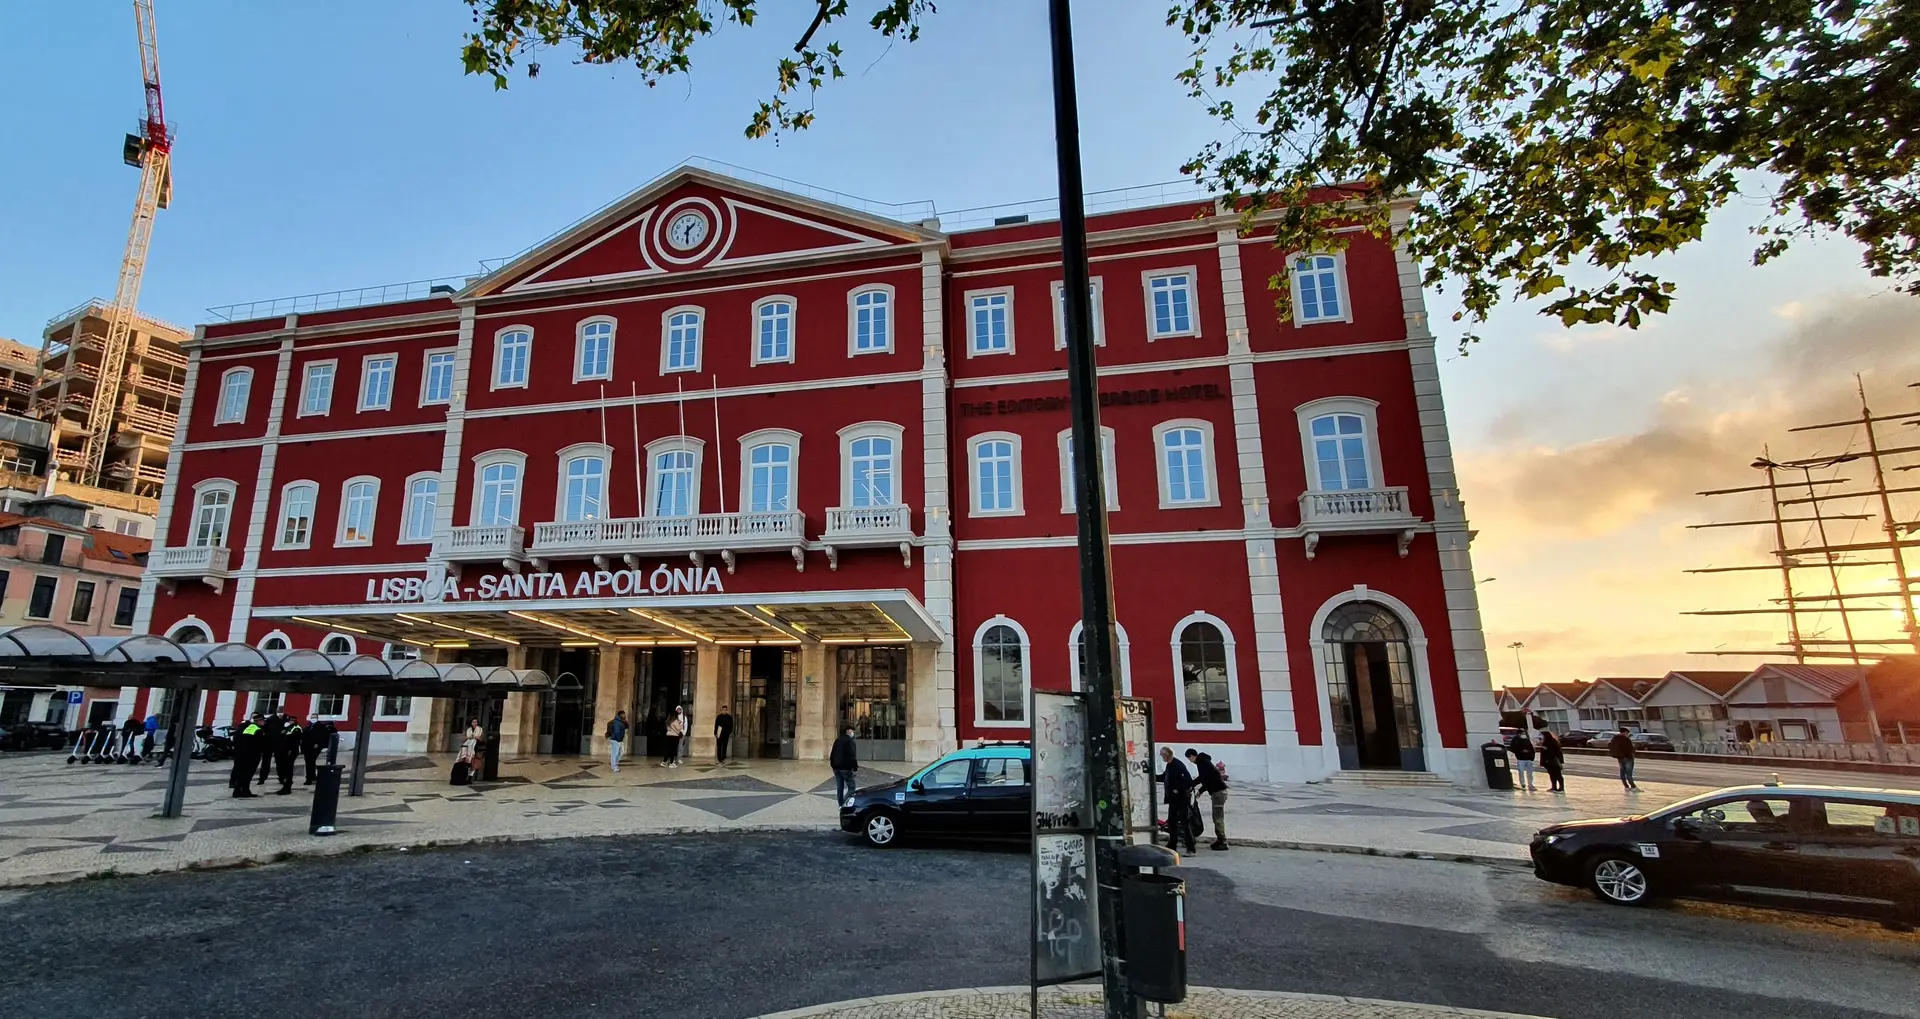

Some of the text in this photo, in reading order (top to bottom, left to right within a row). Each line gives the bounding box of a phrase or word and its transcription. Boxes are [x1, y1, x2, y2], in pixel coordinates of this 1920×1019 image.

[960, 401, 993, 417] THE
[1165, 384, 1226, 402] HOTEL
[366, 577, 460, 601] LISBOA
[478, 573, 567, 598] SANTA
[572, 563, 724, 595] APOLÓNIA
[71, 692, 81, 703] P
